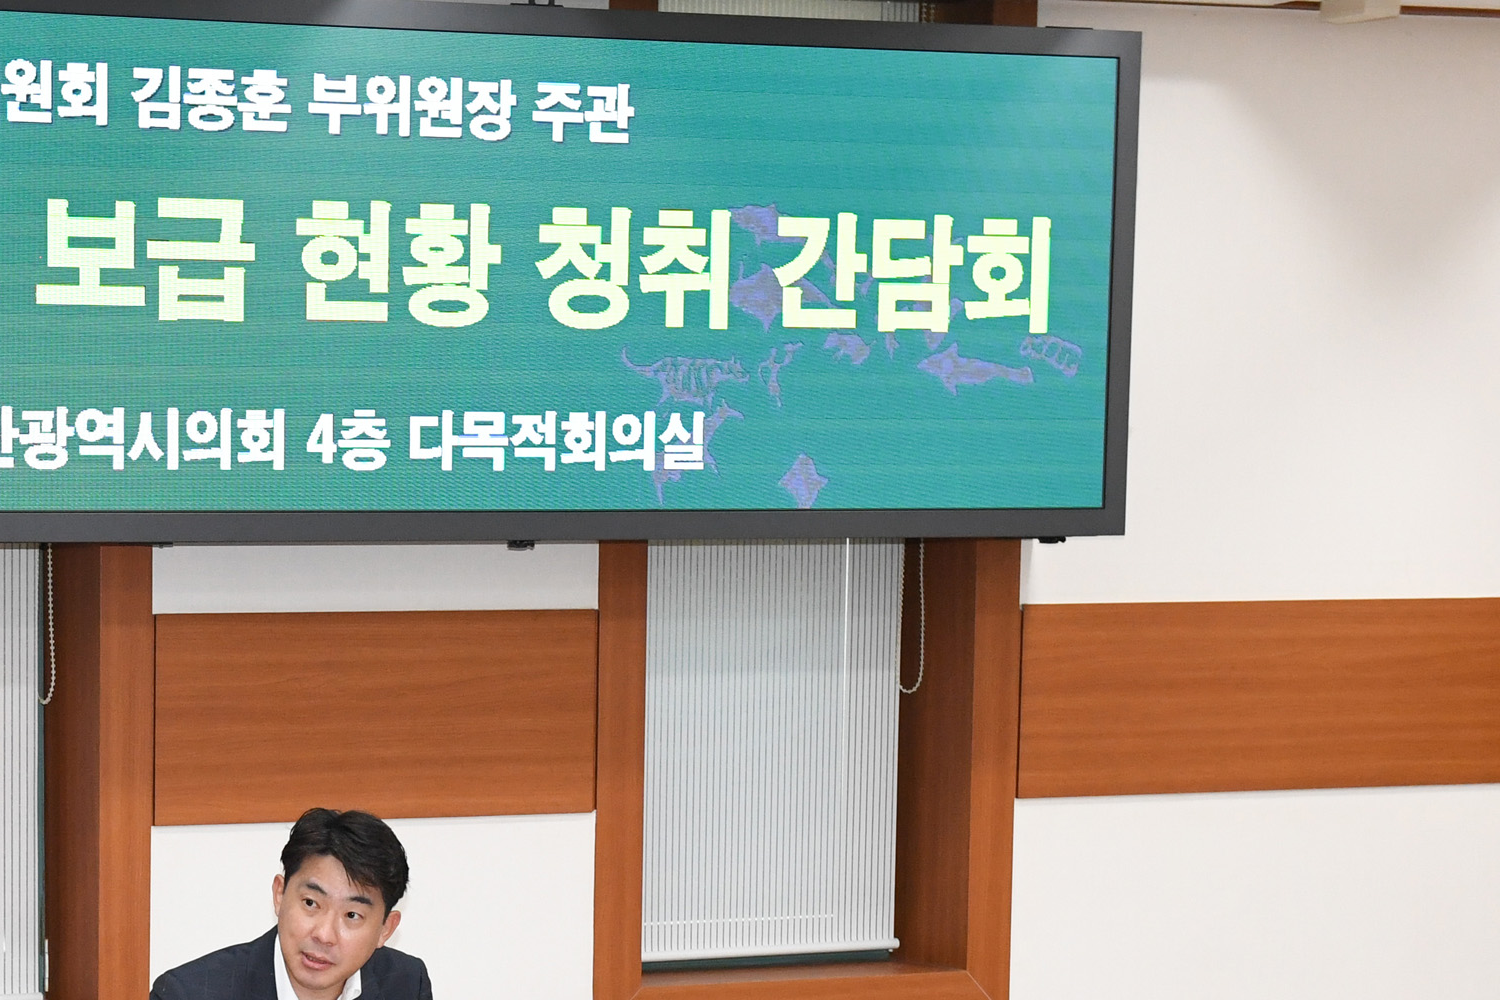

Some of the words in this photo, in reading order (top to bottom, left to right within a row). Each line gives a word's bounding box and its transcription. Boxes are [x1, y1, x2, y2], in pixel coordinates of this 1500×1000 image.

[131, 64, 292, 133] 김종훈
[307, 71, 518, 142] 부위원장
[532, 81, 636, 145] 주관
[35, 196, 256, 323] 보급
[295, 200, 502, 329] 현황
[534, 206, 732, 331] 청취
[771, 211, 1053, 335] 간담회
[305, 409, 392, 473] 4층
[408, 408, 707, 474] 다목적회의실
